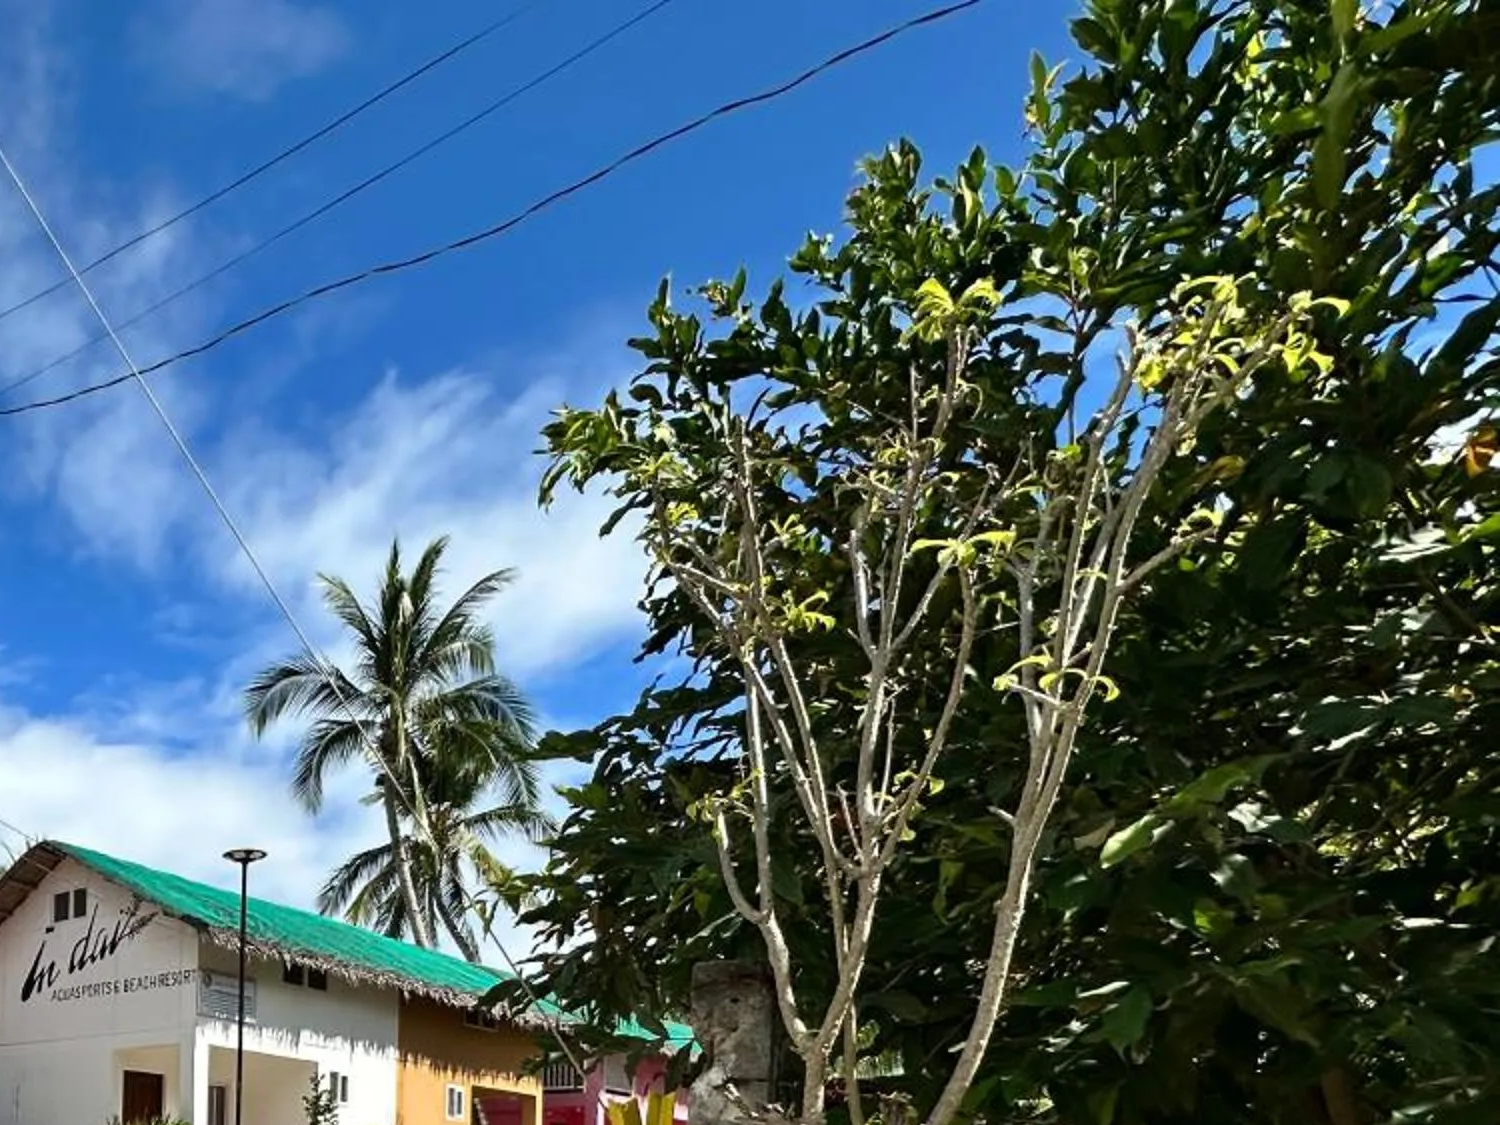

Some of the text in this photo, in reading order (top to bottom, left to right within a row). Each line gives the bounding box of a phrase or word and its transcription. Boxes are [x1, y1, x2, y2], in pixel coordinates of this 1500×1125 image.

[52, 980, 111, 1001] AQUASPORTS
[123, 975, 156, 993] BEACH
[158, 969, 196, 988] RESORT
